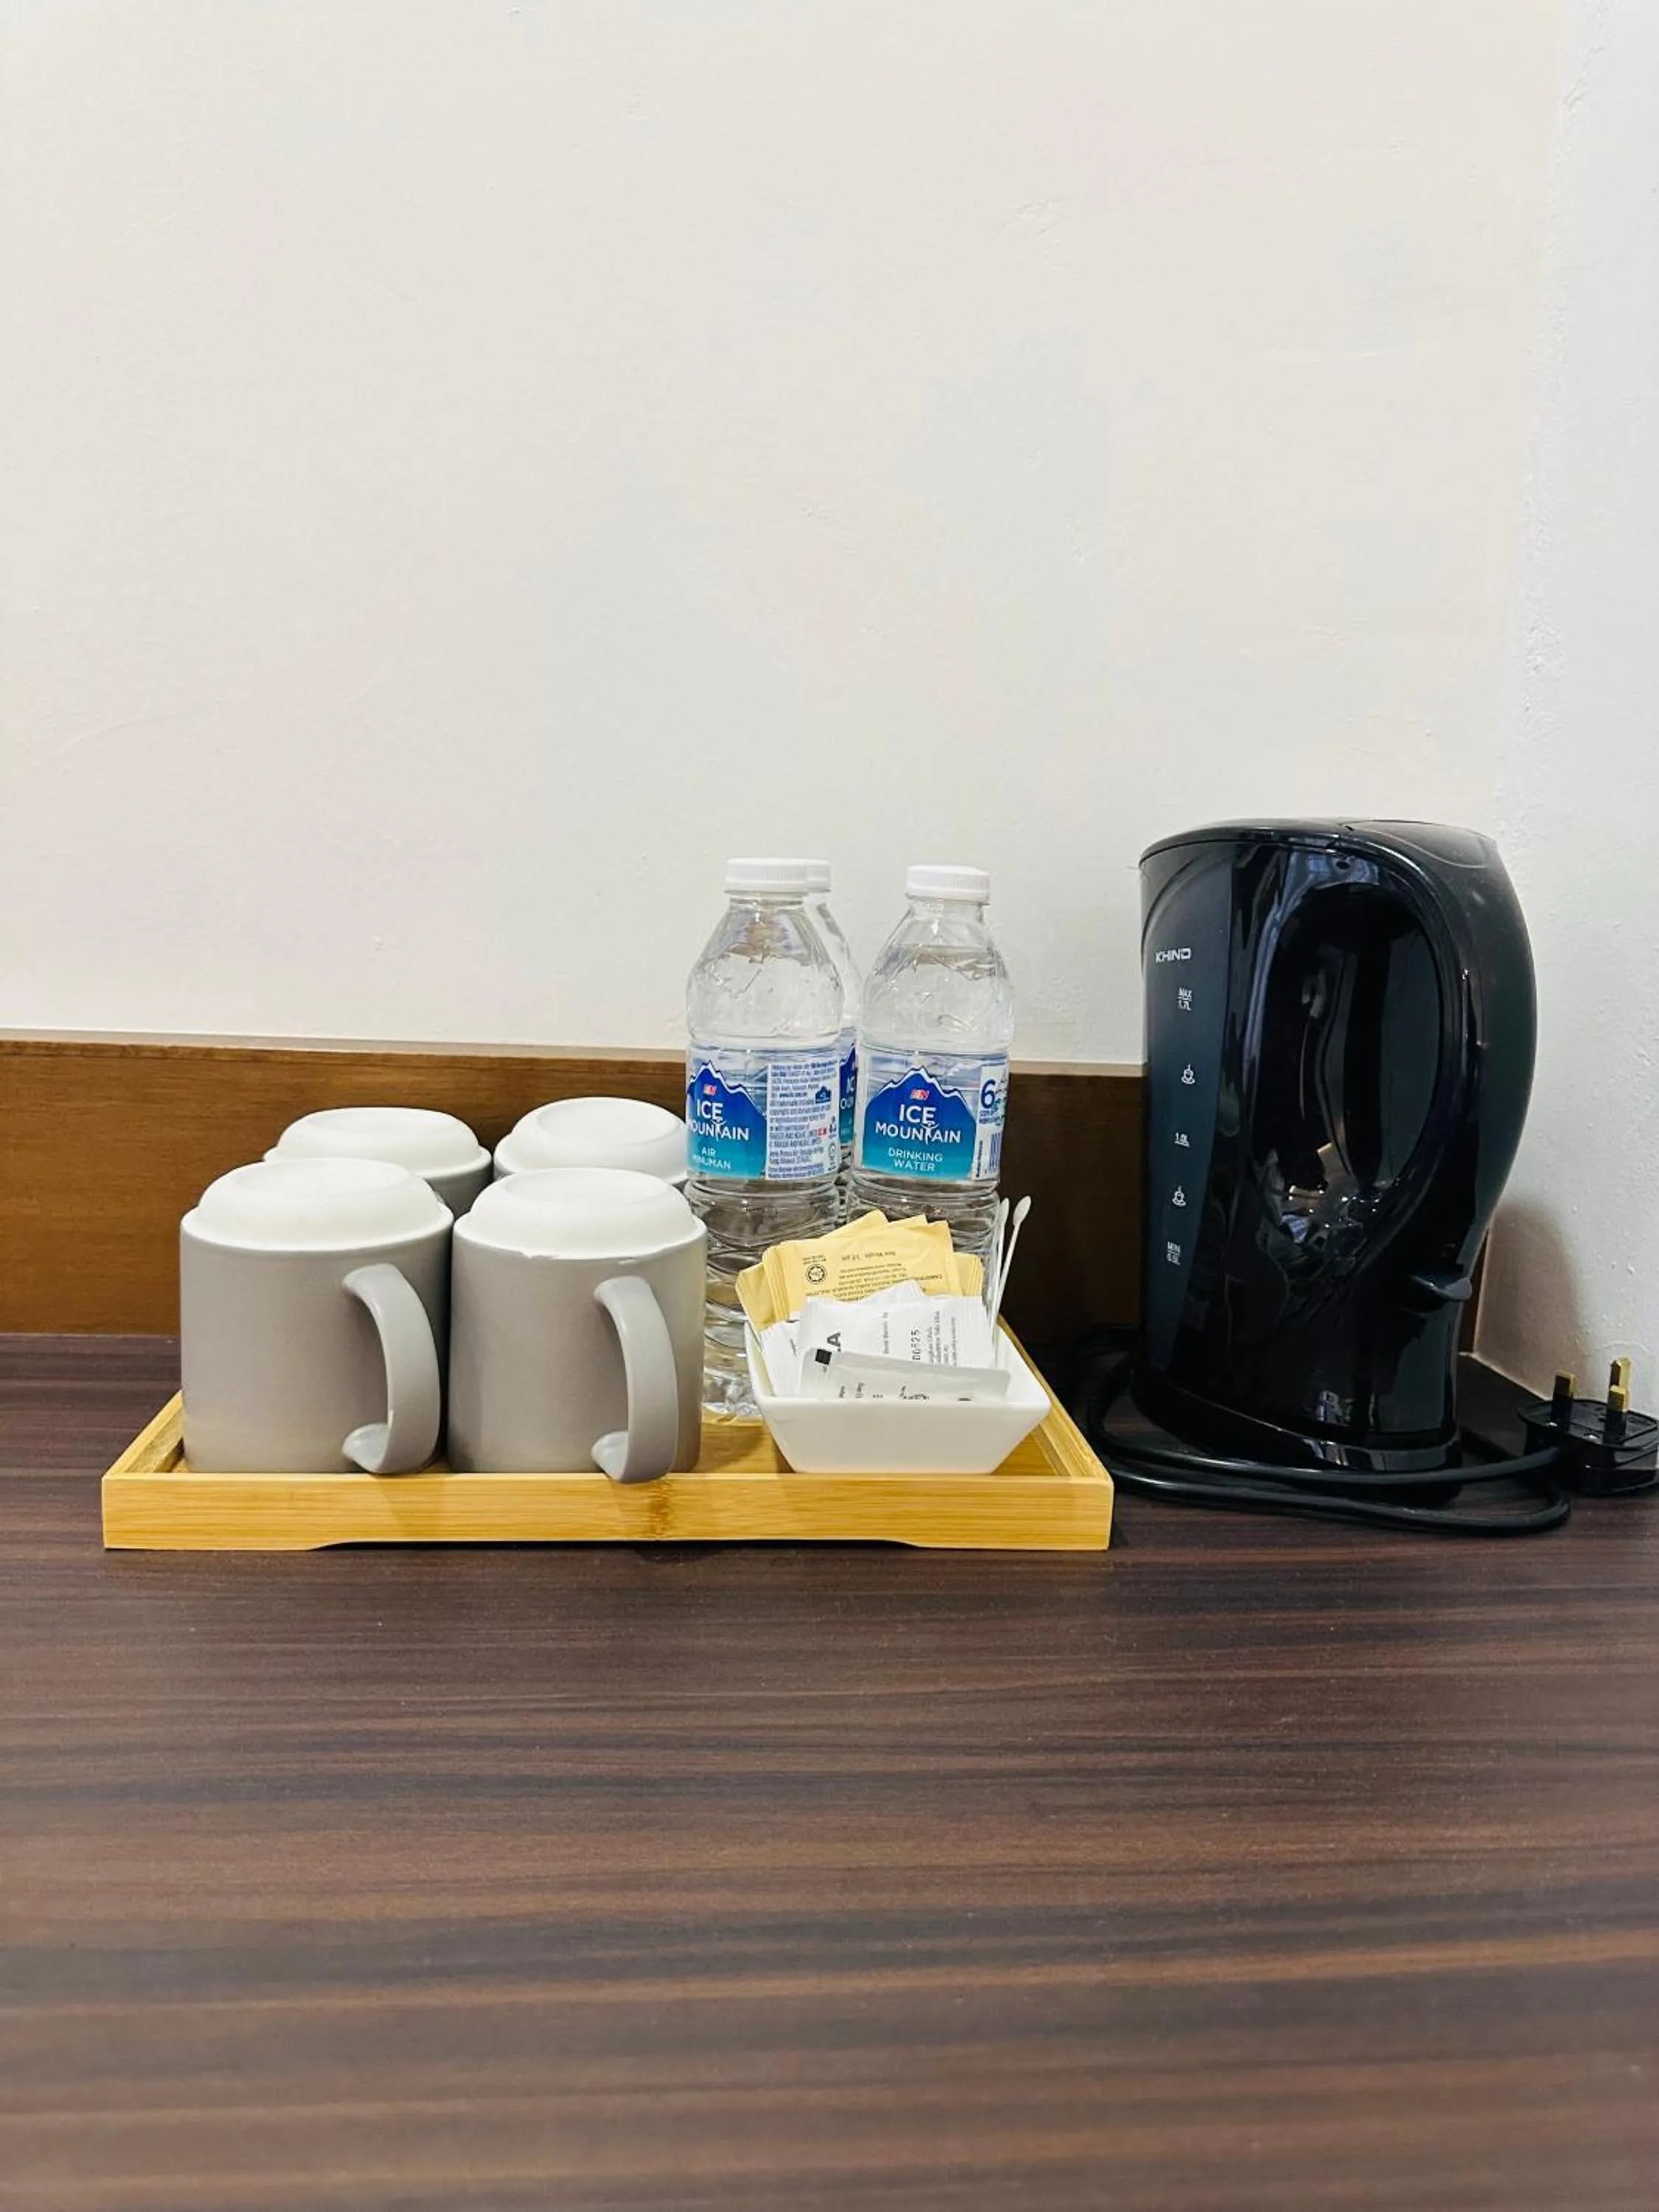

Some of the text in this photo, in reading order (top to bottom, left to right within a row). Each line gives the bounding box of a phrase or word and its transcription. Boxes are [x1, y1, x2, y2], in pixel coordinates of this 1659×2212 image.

[1155, 947, 1192, 963] KHIND
[697, 1099, 723, 1121] ICE
[899, 1104, 937, 1125] ICE
[875, 1121, 961, 1144] MOUNTAIN
[701, 1147, 716, 1157] AIR
[888, 1147, 944, 1163] DRINKING
[893, 1158, 936, 1172] WATER
